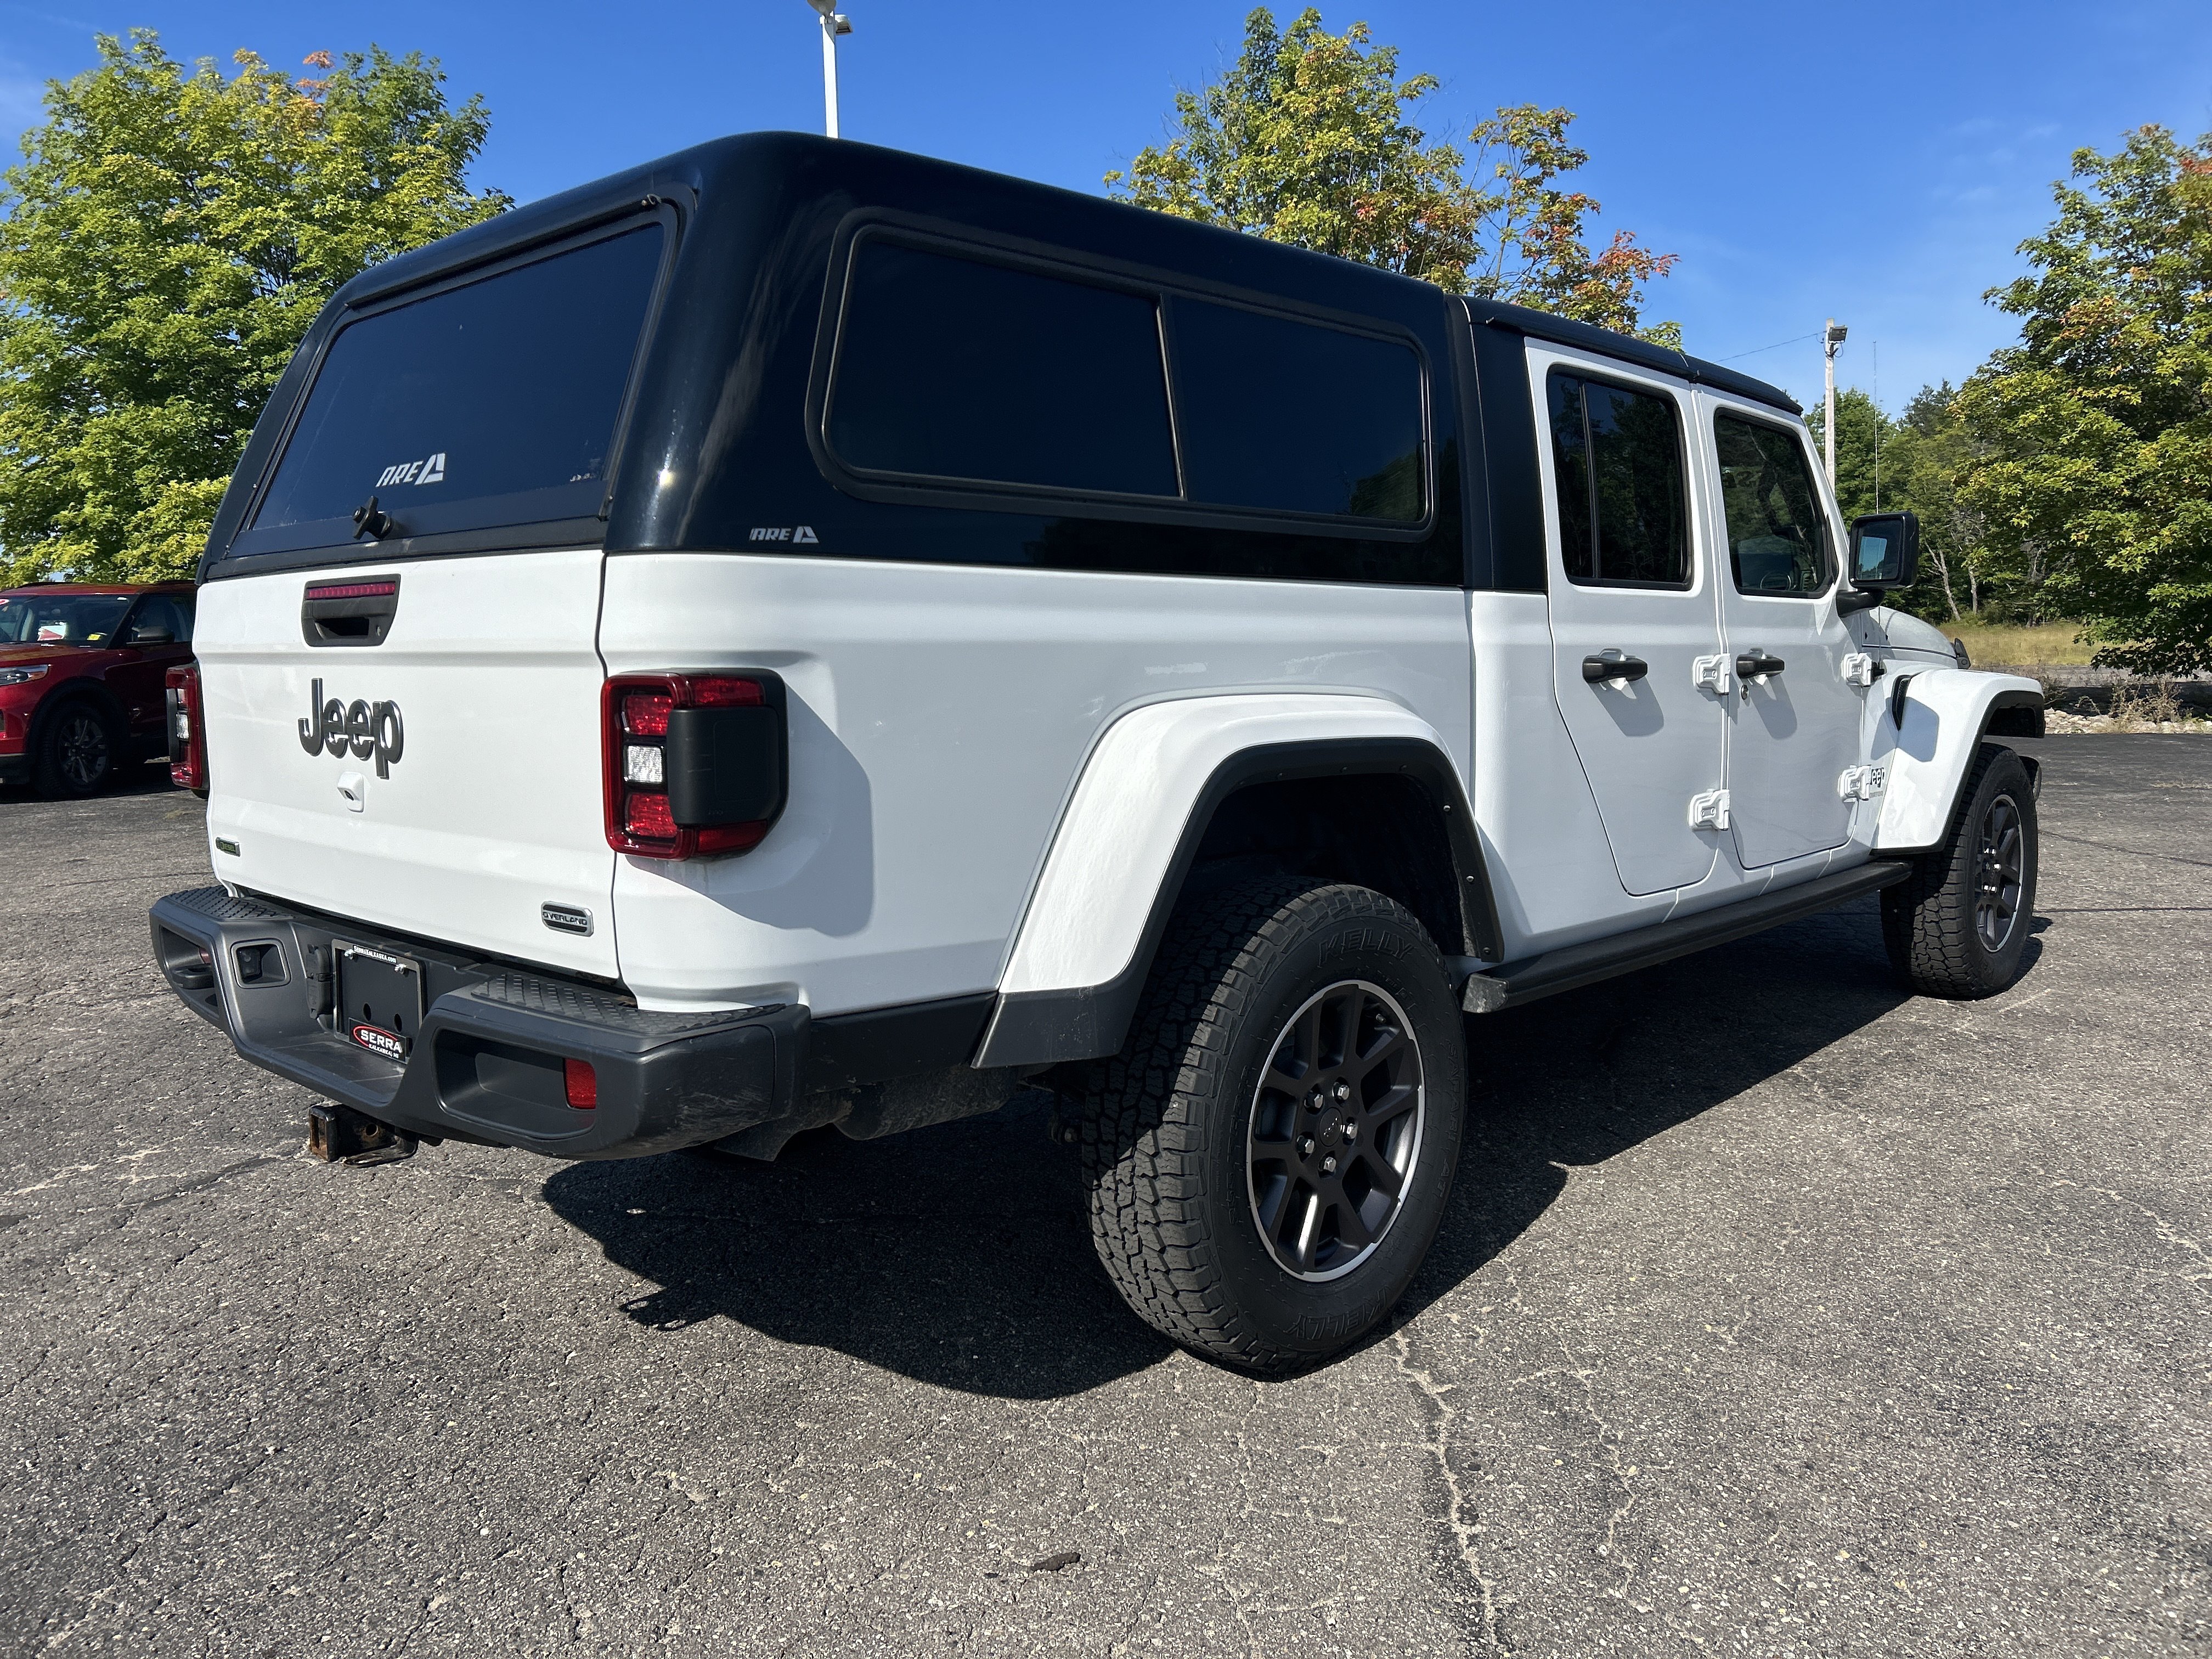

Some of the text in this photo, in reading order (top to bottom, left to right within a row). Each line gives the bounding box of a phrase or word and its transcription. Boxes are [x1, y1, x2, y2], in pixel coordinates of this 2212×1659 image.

[375, 460, 424, 487] ARE
[749, 528, 791, 541] ARE
[298, 678, 404, 780] Jeep
[1869, 768, 1886, 788] eep
[543, 911, 587, 925] OVERLAND
[1318, 928, 1414, 966] KELLY
[360, 1029, 402, 1053] SERRA
[1446, 1039, 1460, 1143] SAFARI
[1285, 1286, 1387, 1340] KELLY
